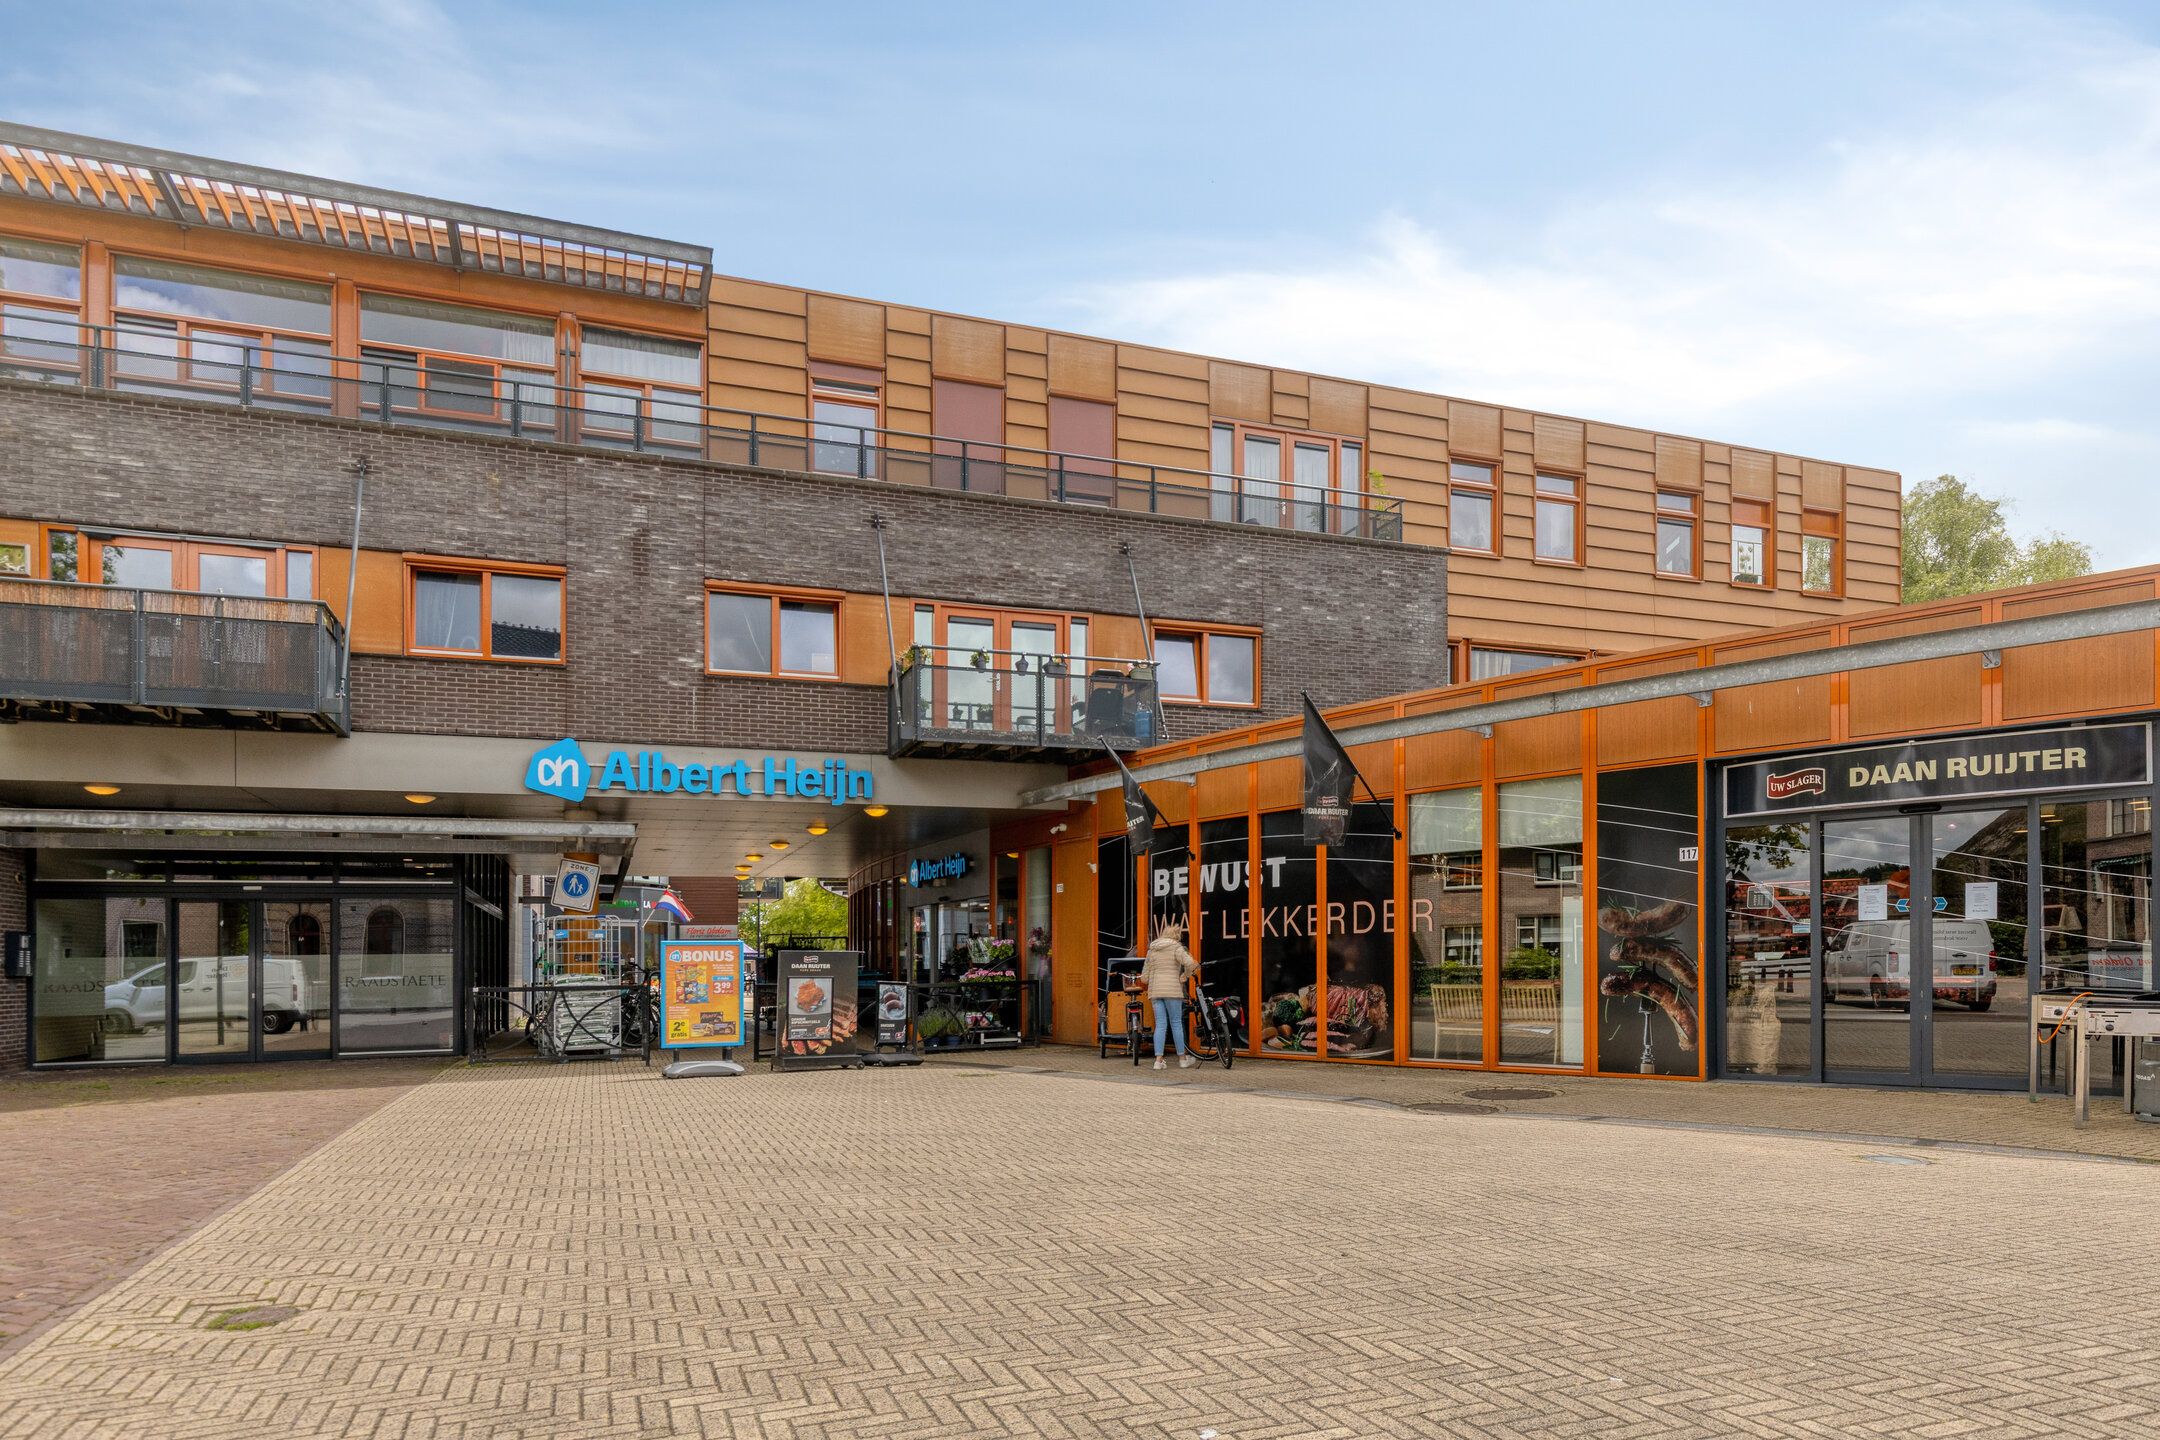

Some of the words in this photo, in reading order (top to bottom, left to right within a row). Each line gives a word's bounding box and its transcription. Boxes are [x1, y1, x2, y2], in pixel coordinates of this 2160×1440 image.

[1850, 759, 1937, 787] DAAN
[1947, 747, 2087, 779] RUIJTER
[598, 750, 752, 796] Albert
[763, 756, 874, 806] Heijn
[1770, 782, 1786, 792] UW
[1786, 774, 1822, 790] SLAGER
[1680, 848, 1697, 861] 117
[570, 863, 589, 872] ZONE
[919, 858, 944, 881] Albert
[945, 852, 966, 879] Heijn
[1222, 898, 1434, 940] LEKKERDER
[682, 950, 735, 962] BONUS
[345, 975, 446, 988] RAADSTAETE
